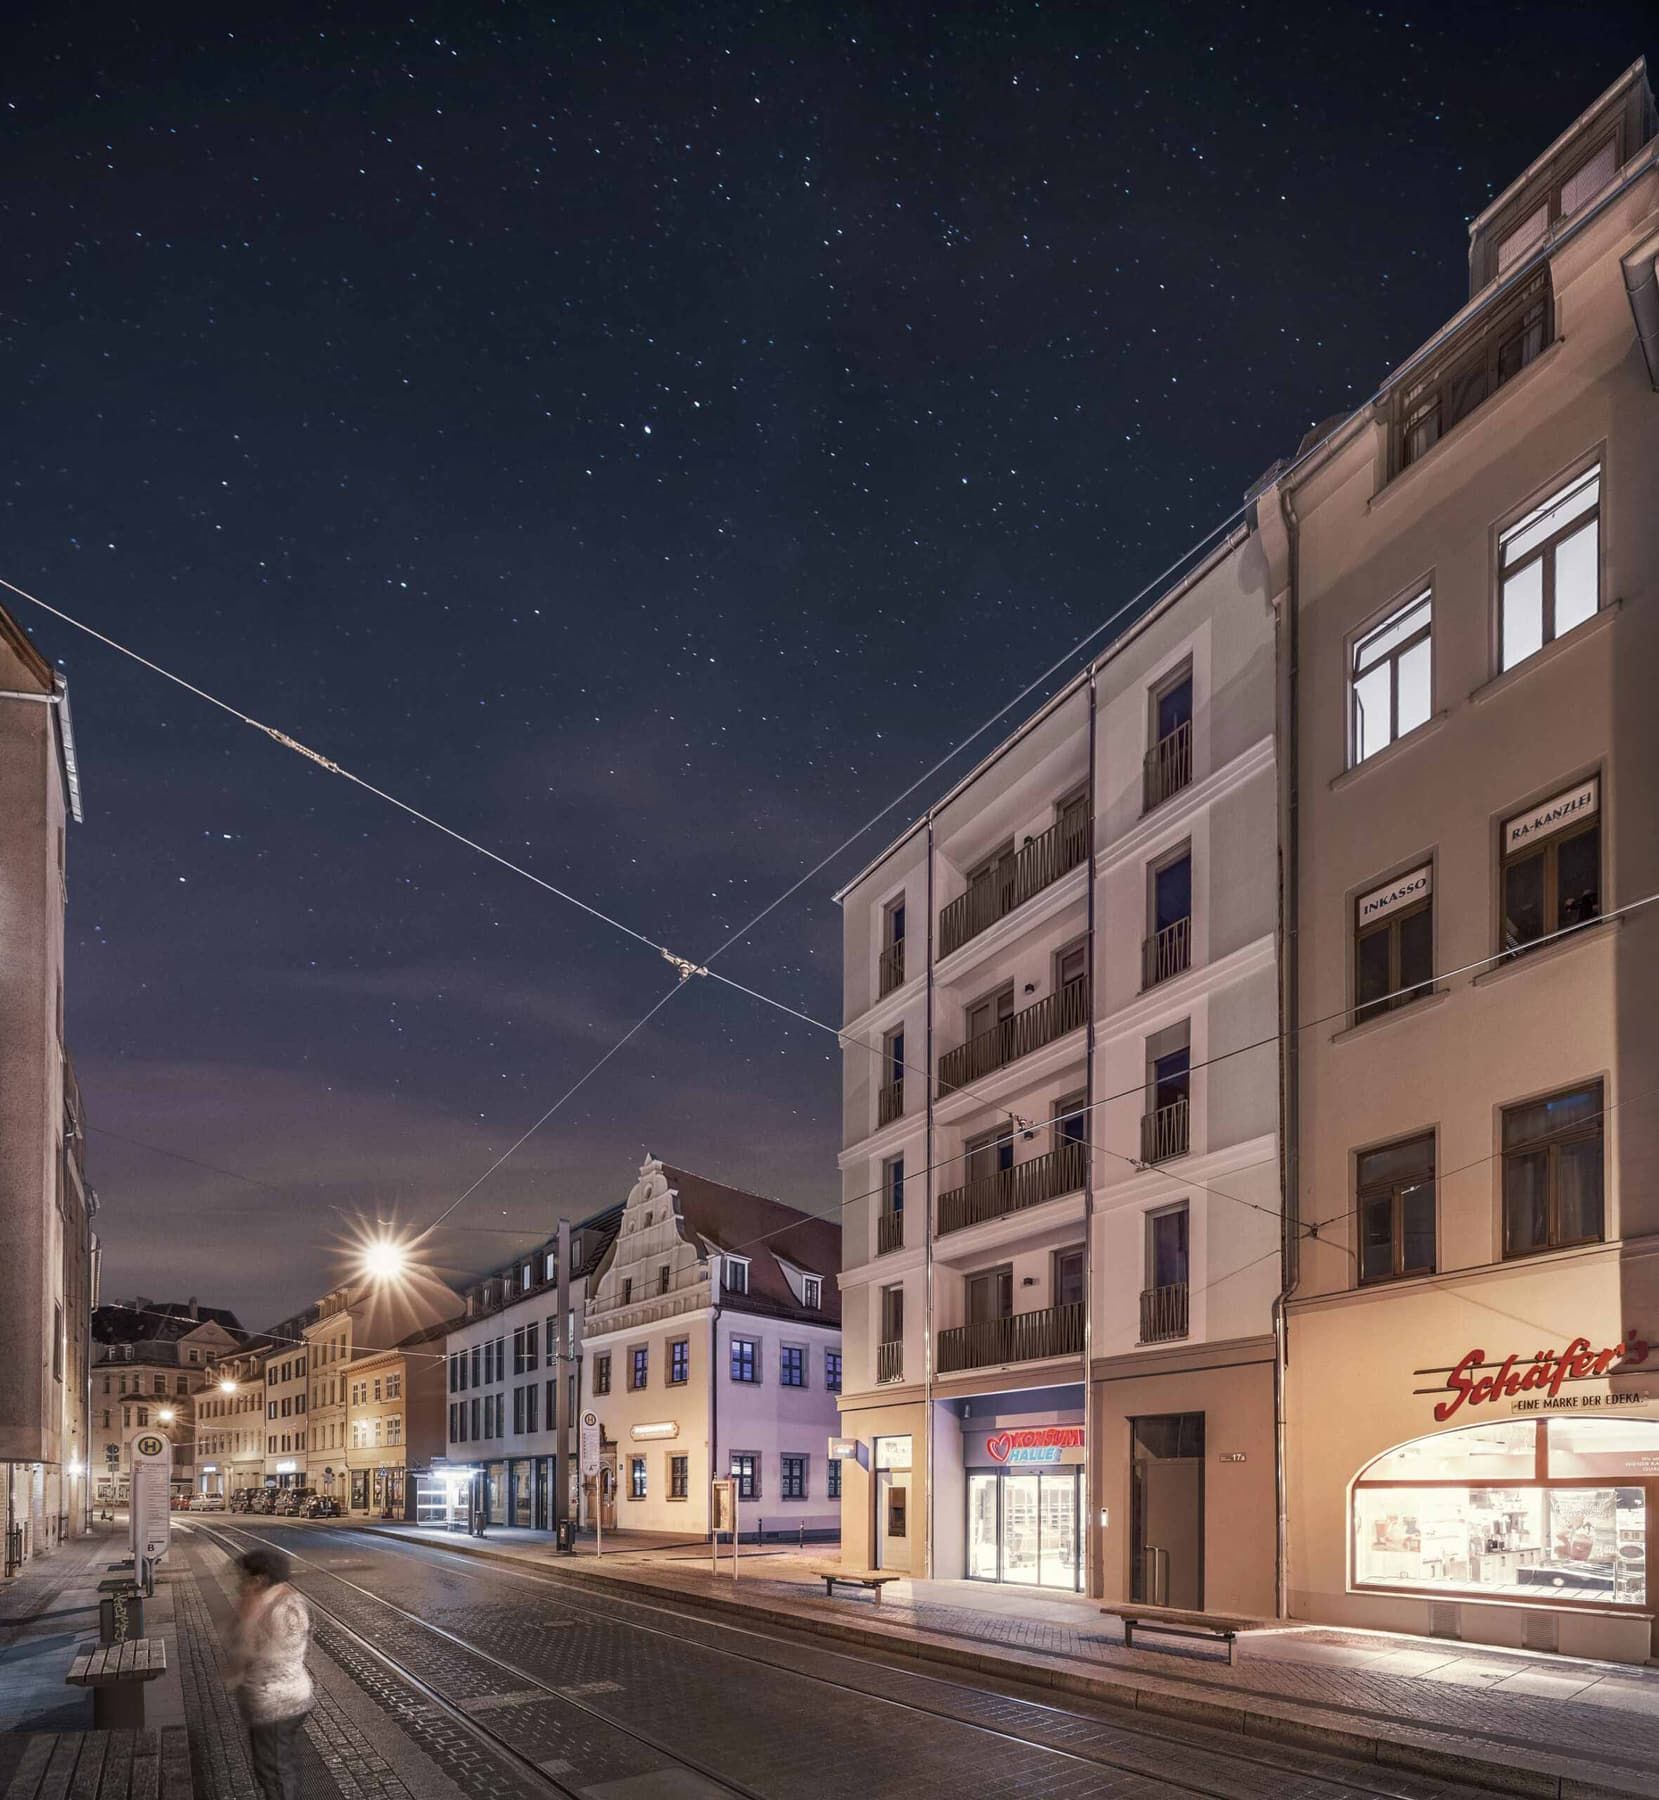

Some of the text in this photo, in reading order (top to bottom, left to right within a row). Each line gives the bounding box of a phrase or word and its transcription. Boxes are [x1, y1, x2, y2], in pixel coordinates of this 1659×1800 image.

[1511, 791, 1591, 840] RA-KANZLEI
[1363, 878, 1426, 915] INKASSO
[1433, 1329, 1649, 1422] Schäfer's
[1517, 1399, 1540, 1410] EINE
[1543, 1396, 1579, 1408] MARKE
[1582, 1395, 1601, 1406] DER
[1010, 1428, 1084, 1448] KONSUM
[1009, 1446, 1060, 1462] HALLE
